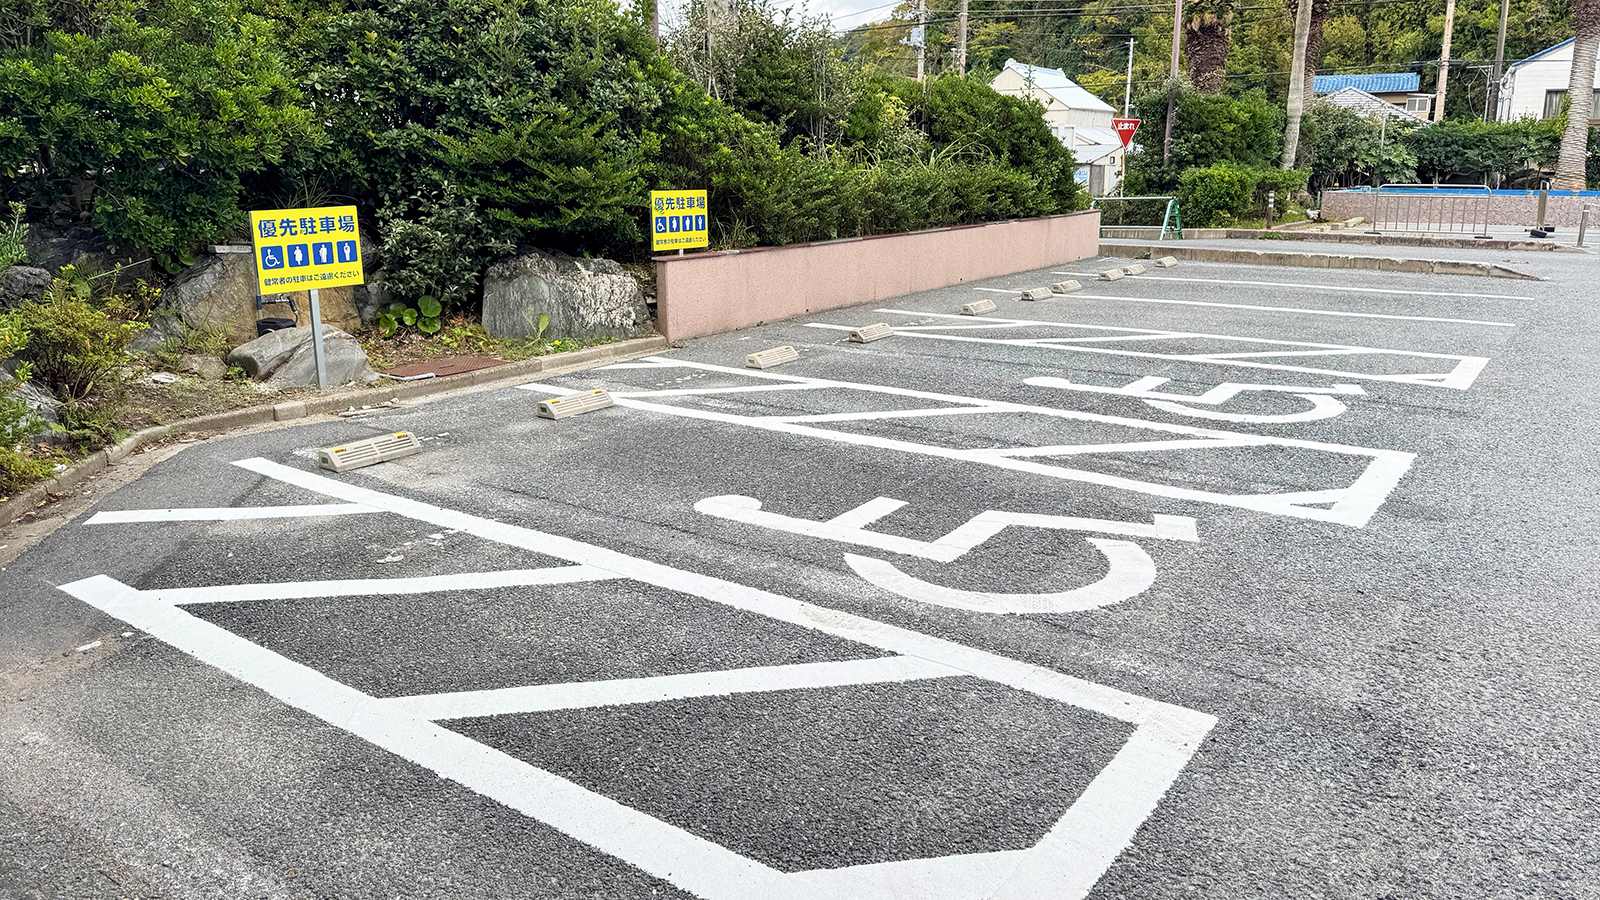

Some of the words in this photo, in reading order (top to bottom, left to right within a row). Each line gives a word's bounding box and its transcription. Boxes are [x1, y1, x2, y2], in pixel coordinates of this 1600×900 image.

[1117, 122, 1135, 130] 止まれ
[655, 196, 705, 210] 優先駐車場
[258, 215, 355, 238] 優先駐車場
[264, 270, 360, 286] 健常者の駐車はご遠慮ください
